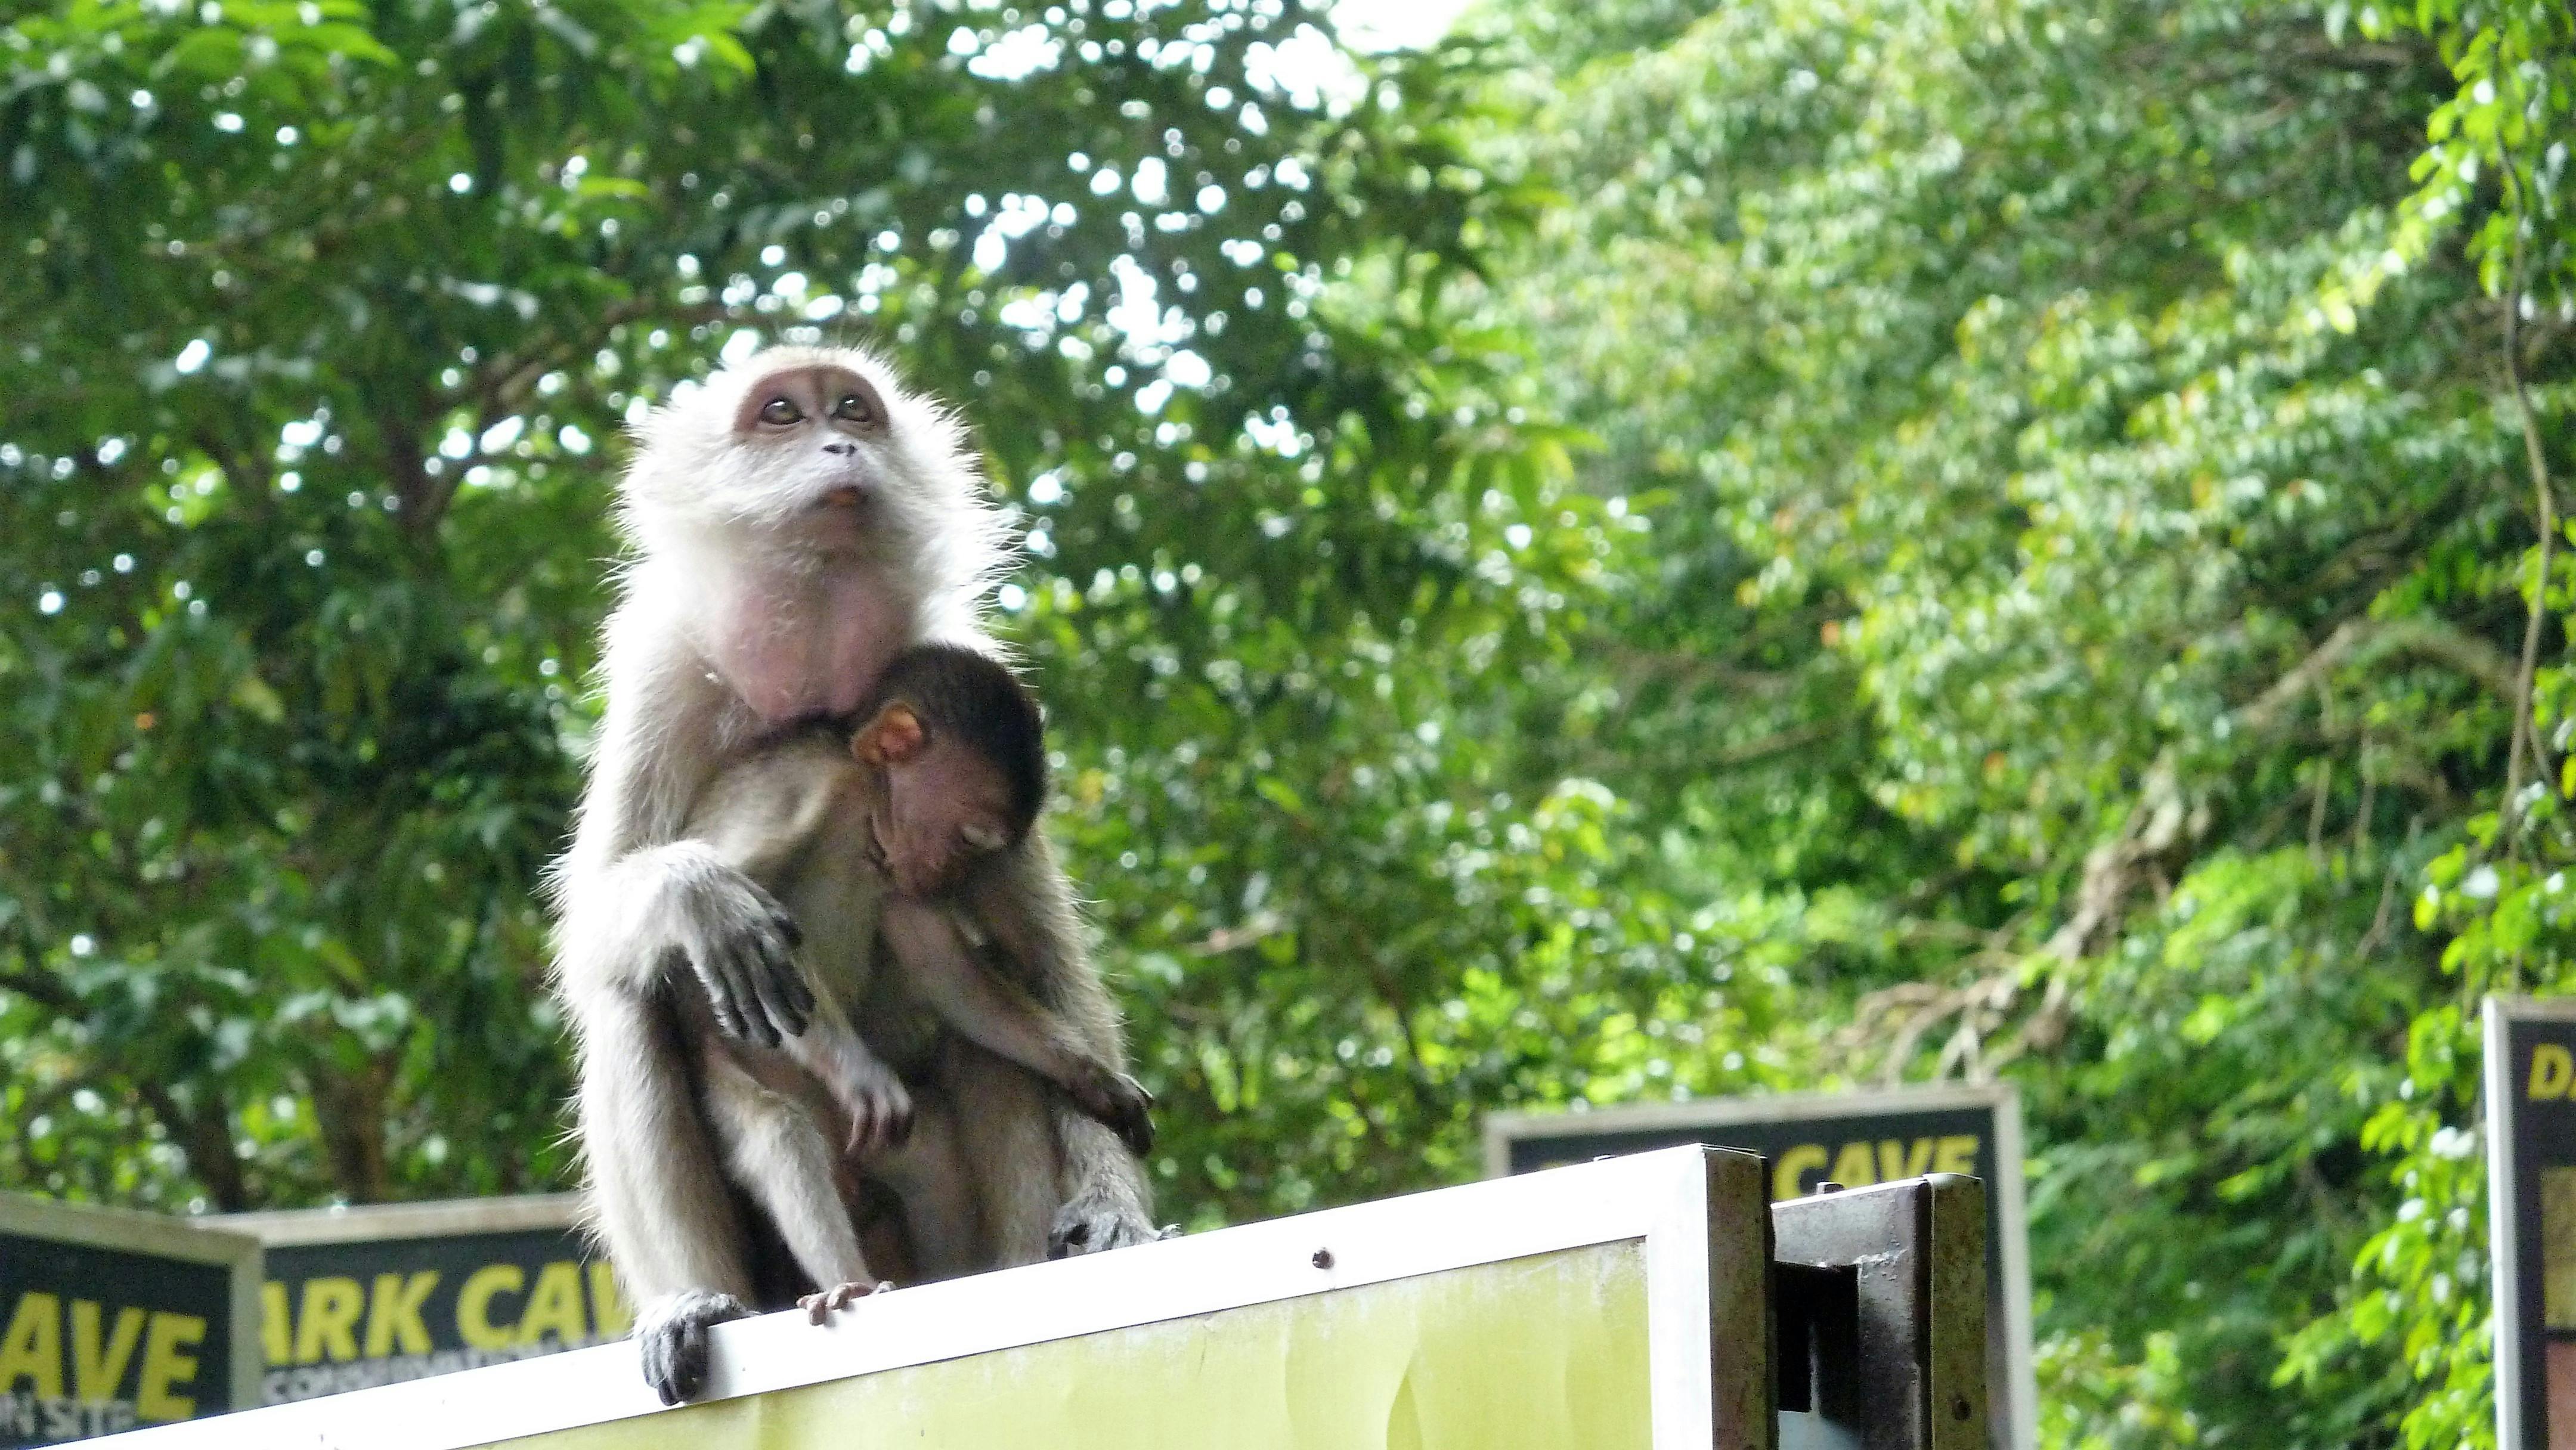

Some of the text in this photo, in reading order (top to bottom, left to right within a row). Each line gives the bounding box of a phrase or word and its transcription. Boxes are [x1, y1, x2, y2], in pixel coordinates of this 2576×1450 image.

[2528, 1042, 2576, 1101] D
[1773, 1135, 1979, 1200] CAVE
[0, 1290, 207, 1420] AVE
